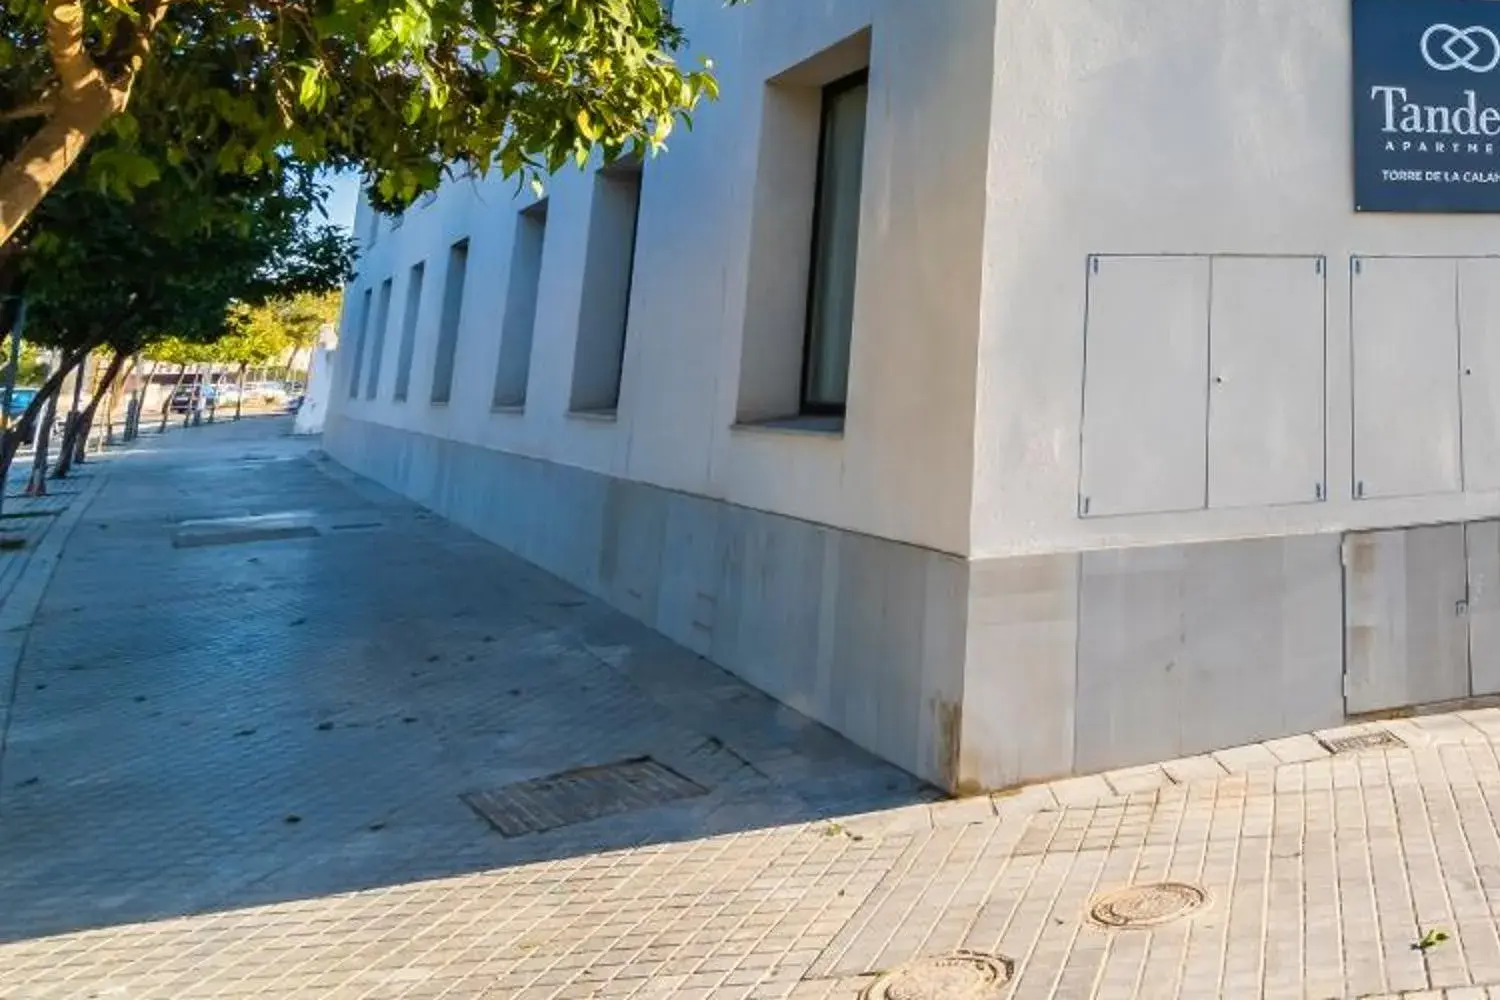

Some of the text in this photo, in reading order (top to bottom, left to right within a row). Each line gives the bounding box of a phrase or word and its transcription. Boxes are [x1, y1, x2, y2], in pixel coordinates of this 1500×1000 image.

[1382, 169, 1423, 181] TORRE
[1425, 170, 1441, 182] DE
[1444, 171, 1460, 182] LA
